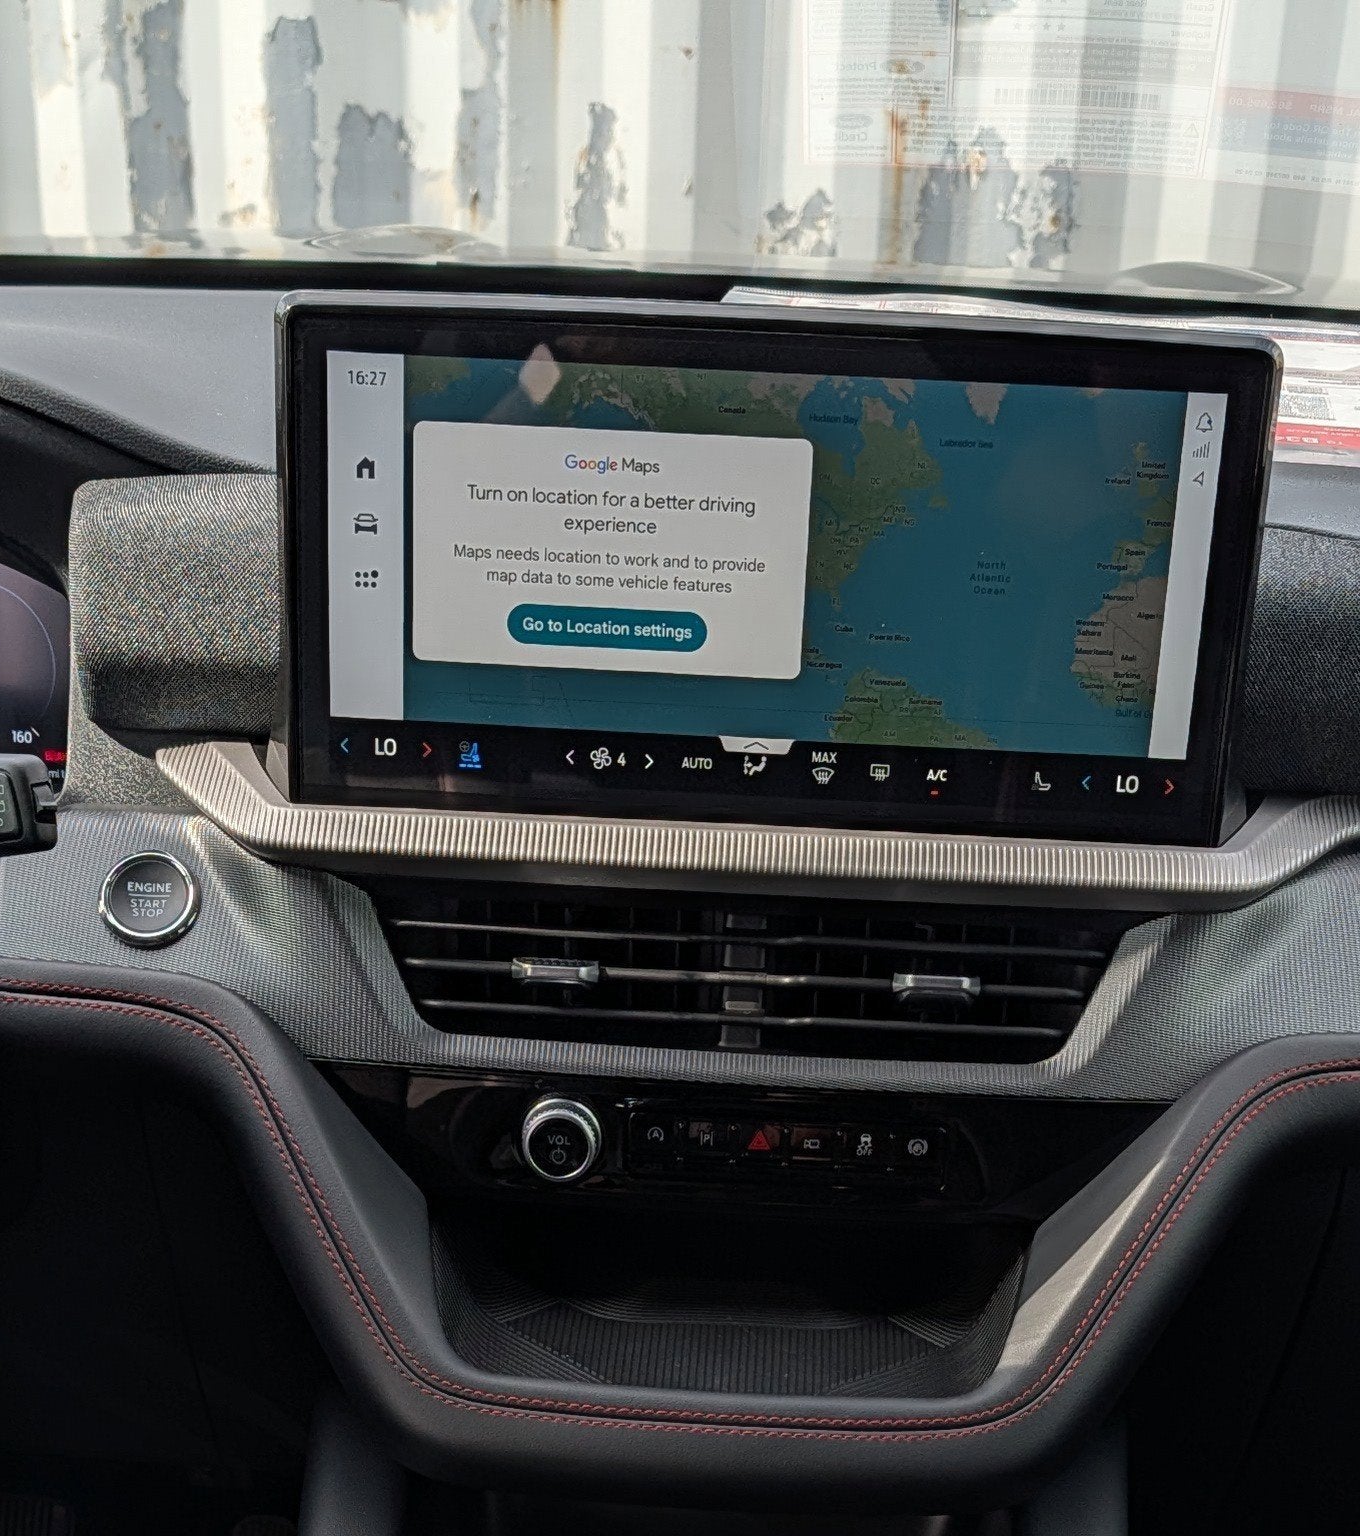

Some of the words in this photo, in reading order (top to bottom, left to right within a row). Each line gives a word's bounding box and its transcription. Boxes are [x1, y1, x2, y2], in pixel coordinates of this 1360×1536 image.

[347, 370, 387, 387] 16:27
[564, 455, 618, 474] Google
[622, 458, 659, 474] Maps
[1142, 461, 1165, 469] United
[1137, 471, 1169, 480] Kingdom
[467, 485, 503, 502] Turn
[507, 489, 527, 502] on
[532, 487, 598, 506] location
[603, 490, 626, 507] for
[630, 496, 640, 508] a
[644, 493, 695, 511] better
[699, 496, 755, 517] driving
[564, 518, 657, 536] experience
[1146, 519, 1171, 527] France
[453, 544, 492, 561] Maps
[496, 546, 540, 562] needs
[544, 548, 601, 565] location
[605, 551, 621, 566] to
[624, 551, 659, 568] work
[663, 553, 690, 569] and
[694, 556, 708, 570] to
[712, 555, 765, 574] provide
[1125, 548, 1145, 557] Spain
[976, 560, 1006, 569] North
[486, 569, 517, 584] map
[521, 568, 553, 585] data
[557, 571, 571, 586] to
[575, 574, 614, 587] some
[618, 574, 668, 591] vehicle
[673, 576, 732, 593] features
[969, 573, 1011, 583] Atlantic
[973, 586, 1005, 596] Ocean
[522, 617, 544, 632] Go
[548, 618, 563, 633] to
[567, 619, 630, 637] Location
[634, 622, 692, 642] settings
[12, 729, 32, 744] 160
[374, 738, 397, 756] LO
[617, 753, 626, 766] 4
[682, 756, 713, 770] AUTO
[811, 751, 837, 764] MAX
[926, 769, 947, 782] A/C
[1116, 775, 1139, 793] LO
[127, 881, 171, 892] ENGINE
[130, 899, 167, 909] START
[132, 909, 163, 918] STOP
[547, 1135, 571, 1146] VOL
